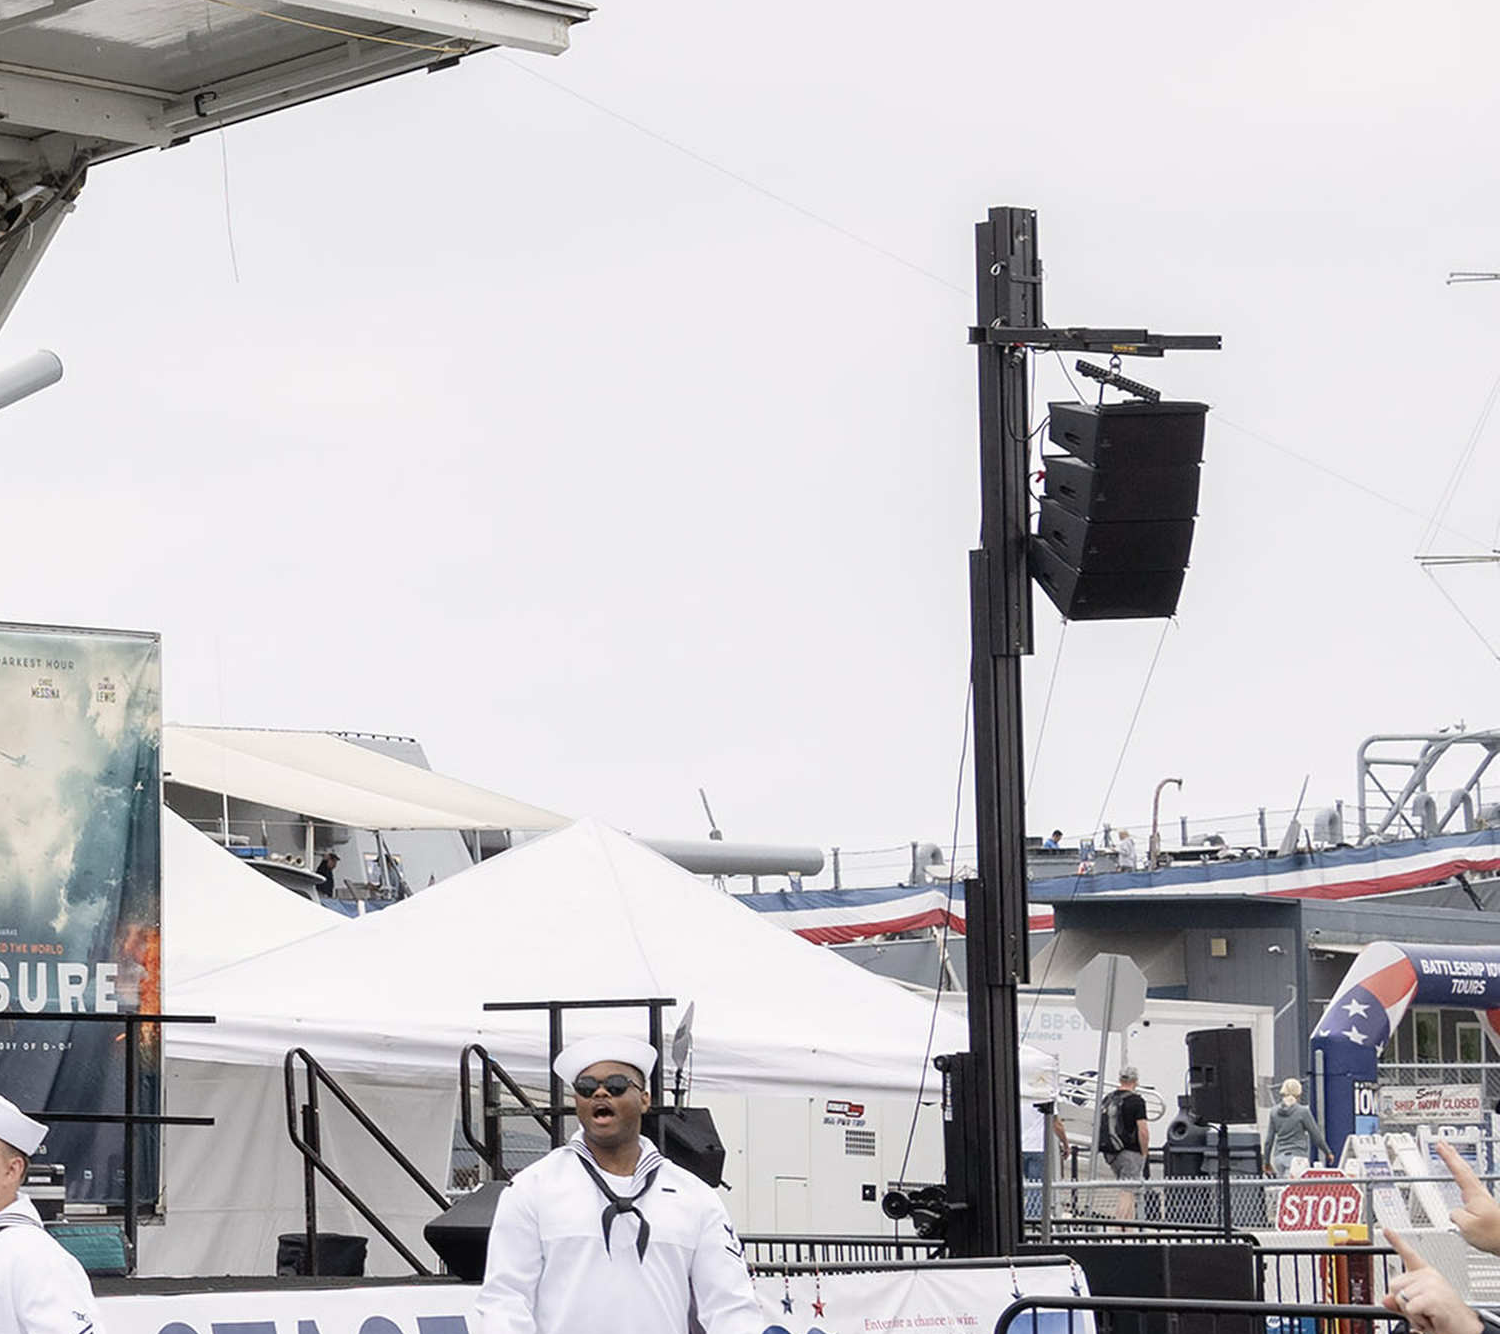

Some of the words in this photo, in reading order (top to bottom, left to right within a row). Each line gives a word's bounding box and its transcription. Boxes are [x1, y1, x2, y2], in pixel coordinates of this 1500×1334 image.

[46, 659, 74, 670] HOUR
[10, 943, 28, 954] THE
[30, 944, 64, 955] WORLD
[1420, 959, 1485, 977] BATTLESHIP
[1451, 979, 1486, 994] TOURS
[23, 1042, 36, 1051] OF
[1394, 1100, 1415, 1111] SHIP
[1418, 1099, 1440, 1110] NOW
[1443, 1098, 1479, 1109] CLOSED
[1282, 1194, 1356, 1226] STOP
